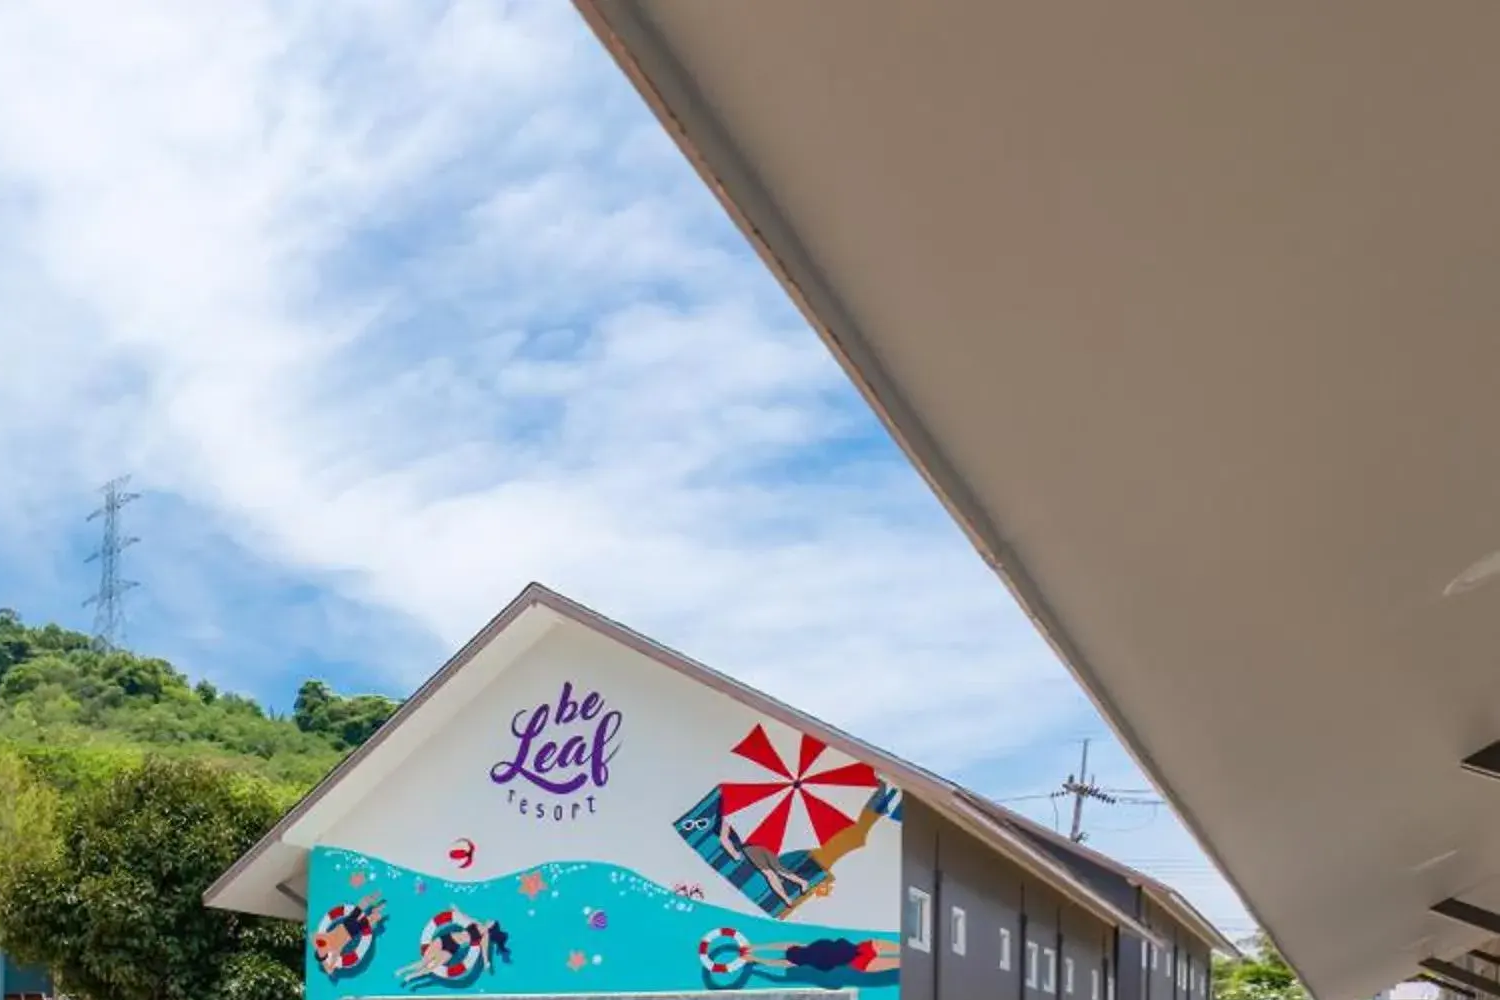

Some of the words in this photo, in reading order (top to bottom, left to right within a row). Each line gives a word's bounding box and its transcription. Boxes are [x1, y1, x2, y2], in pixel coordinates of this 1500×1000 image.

[554, 681, 605, 725] be
[489, 703, 623, 795] Leaf
[507, 789, 597, 822] resort
